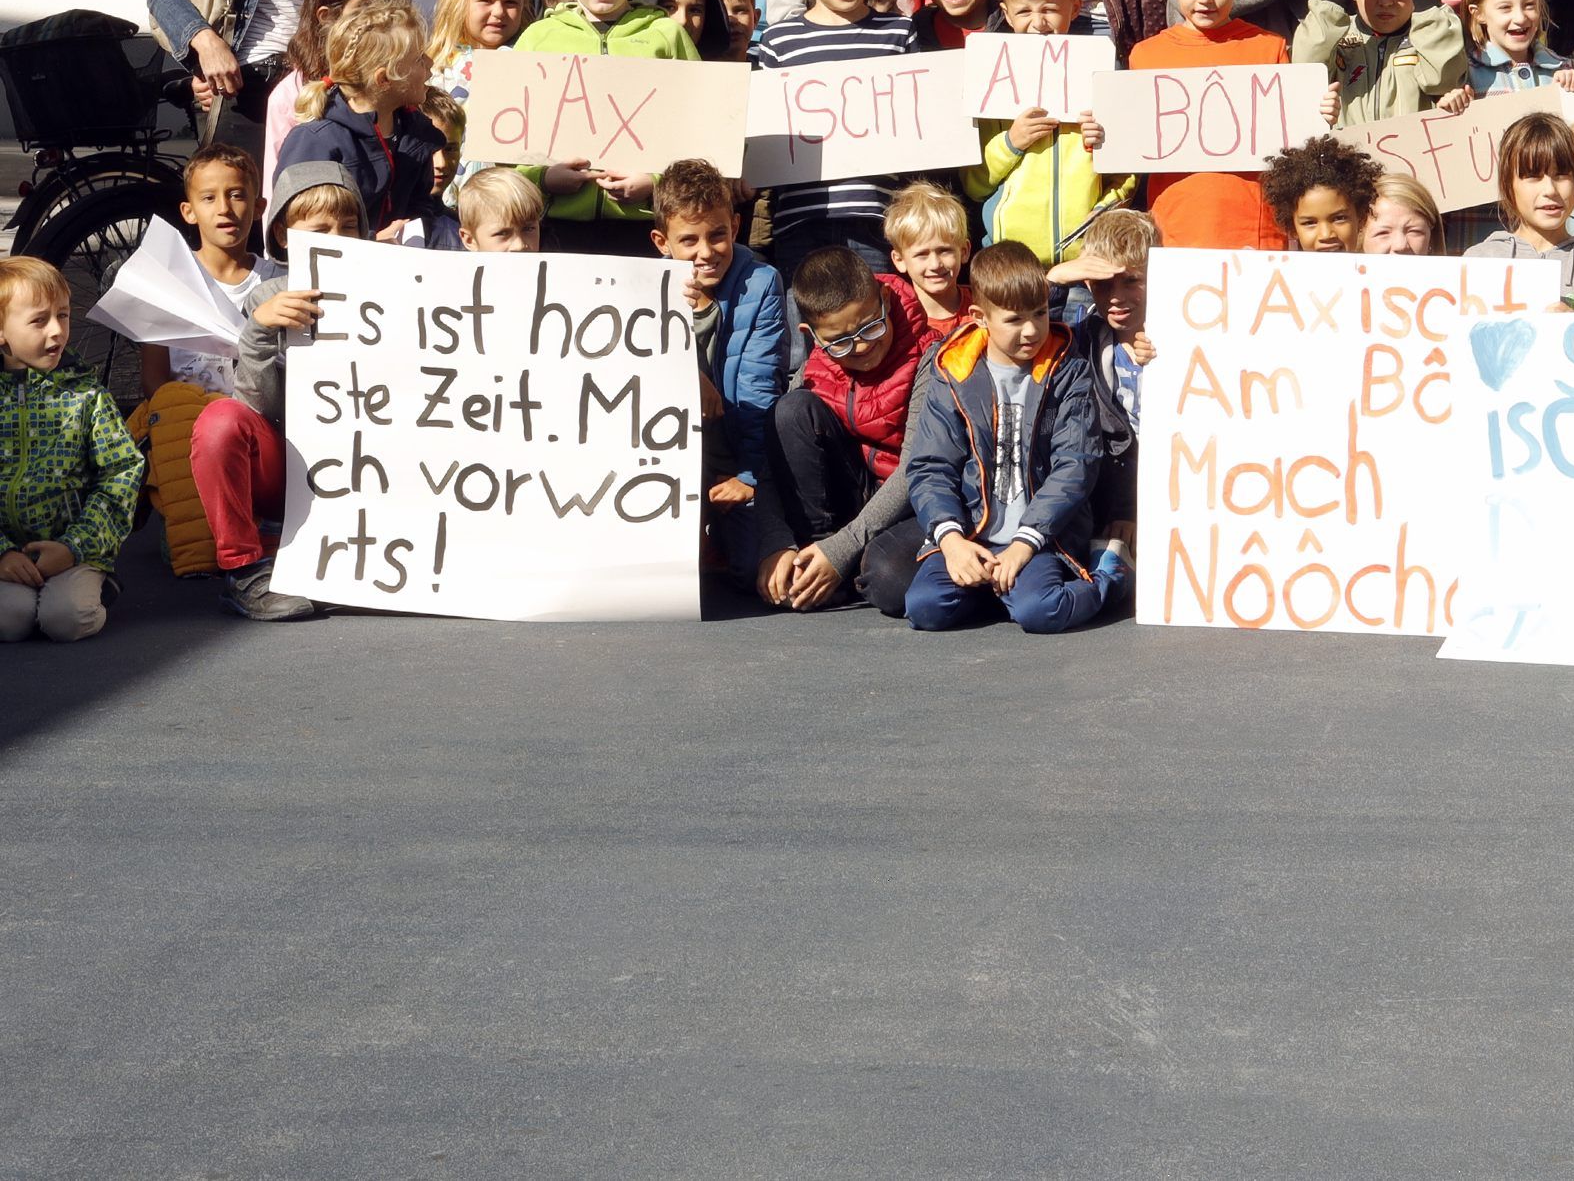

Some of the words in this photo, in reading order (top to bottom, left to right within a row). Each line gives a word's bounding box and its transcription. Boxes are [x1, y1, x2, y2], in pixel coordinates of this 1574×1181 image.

[980, 38, 1069, 114] AM
[1143, 70, 1293, 161] BÔM
[308, 246, 385, 346] Es
[413, 265, 495, 355] ist
[313, 360, 393, 426] ste
[415, 365, 560, 443] Zeit.
[578, 372, 702, 451] Ma-
[1177, 345, 1305, 419] Am
[306, 430, 390, 499] ch
[419, 456, 699, 523] vorwä-
[1168, 399, 1383, 525] Mach
[314, 508, 448, 594] rts!
